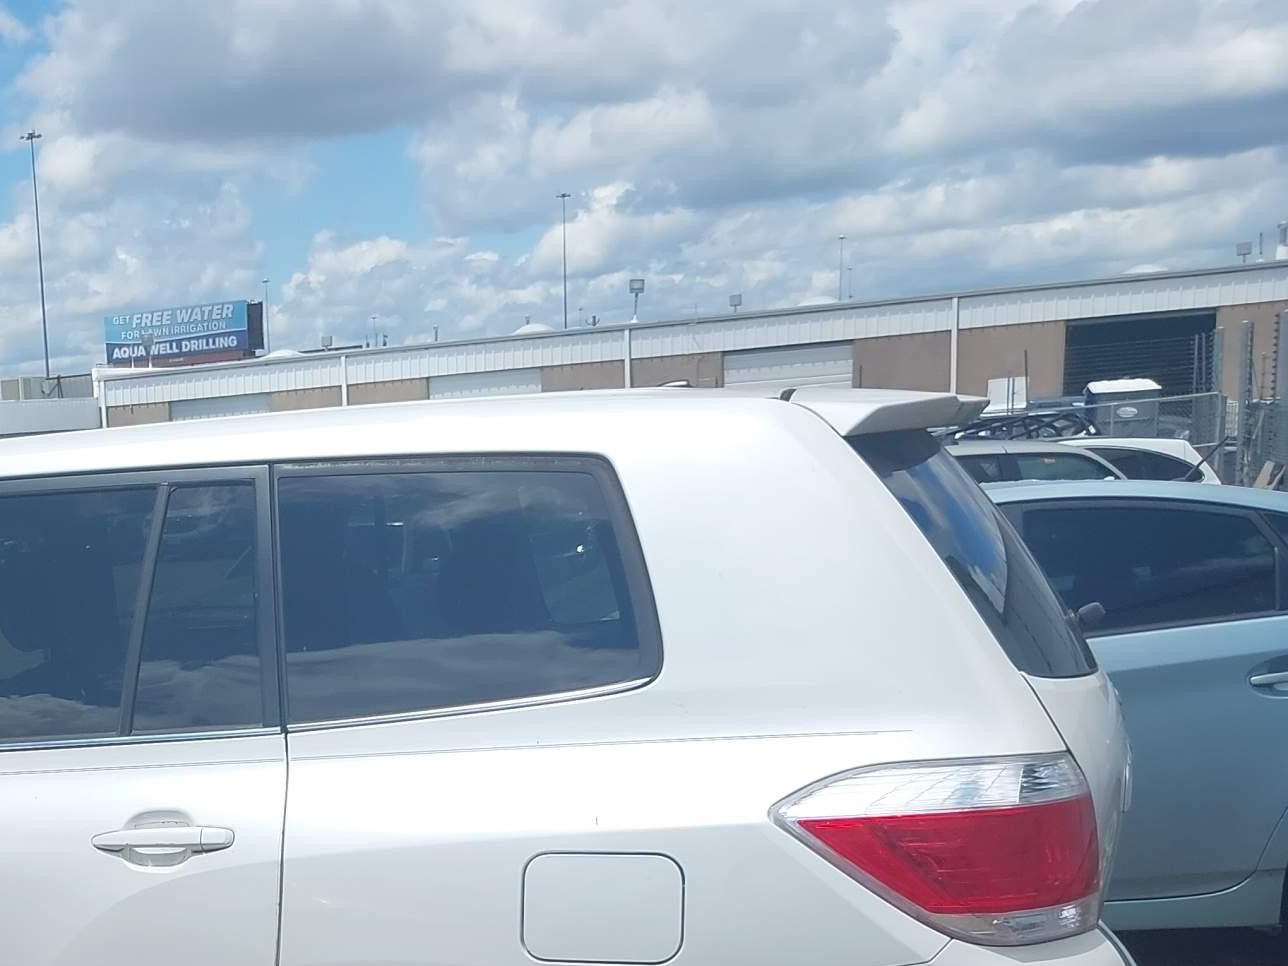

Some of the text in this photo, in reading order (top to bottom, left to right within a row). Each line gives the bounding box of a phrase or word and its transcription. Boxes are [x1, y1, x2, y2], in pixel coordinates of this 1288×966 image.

[112, 303, 233, 328] GET FREE WATER
[121, 330, 140, 340] FOR
[170, 322, 226, 335] IRRIGATION
[112, 345, 146, 359] AQUA
[181, 336, 238, 352] DRILLING
